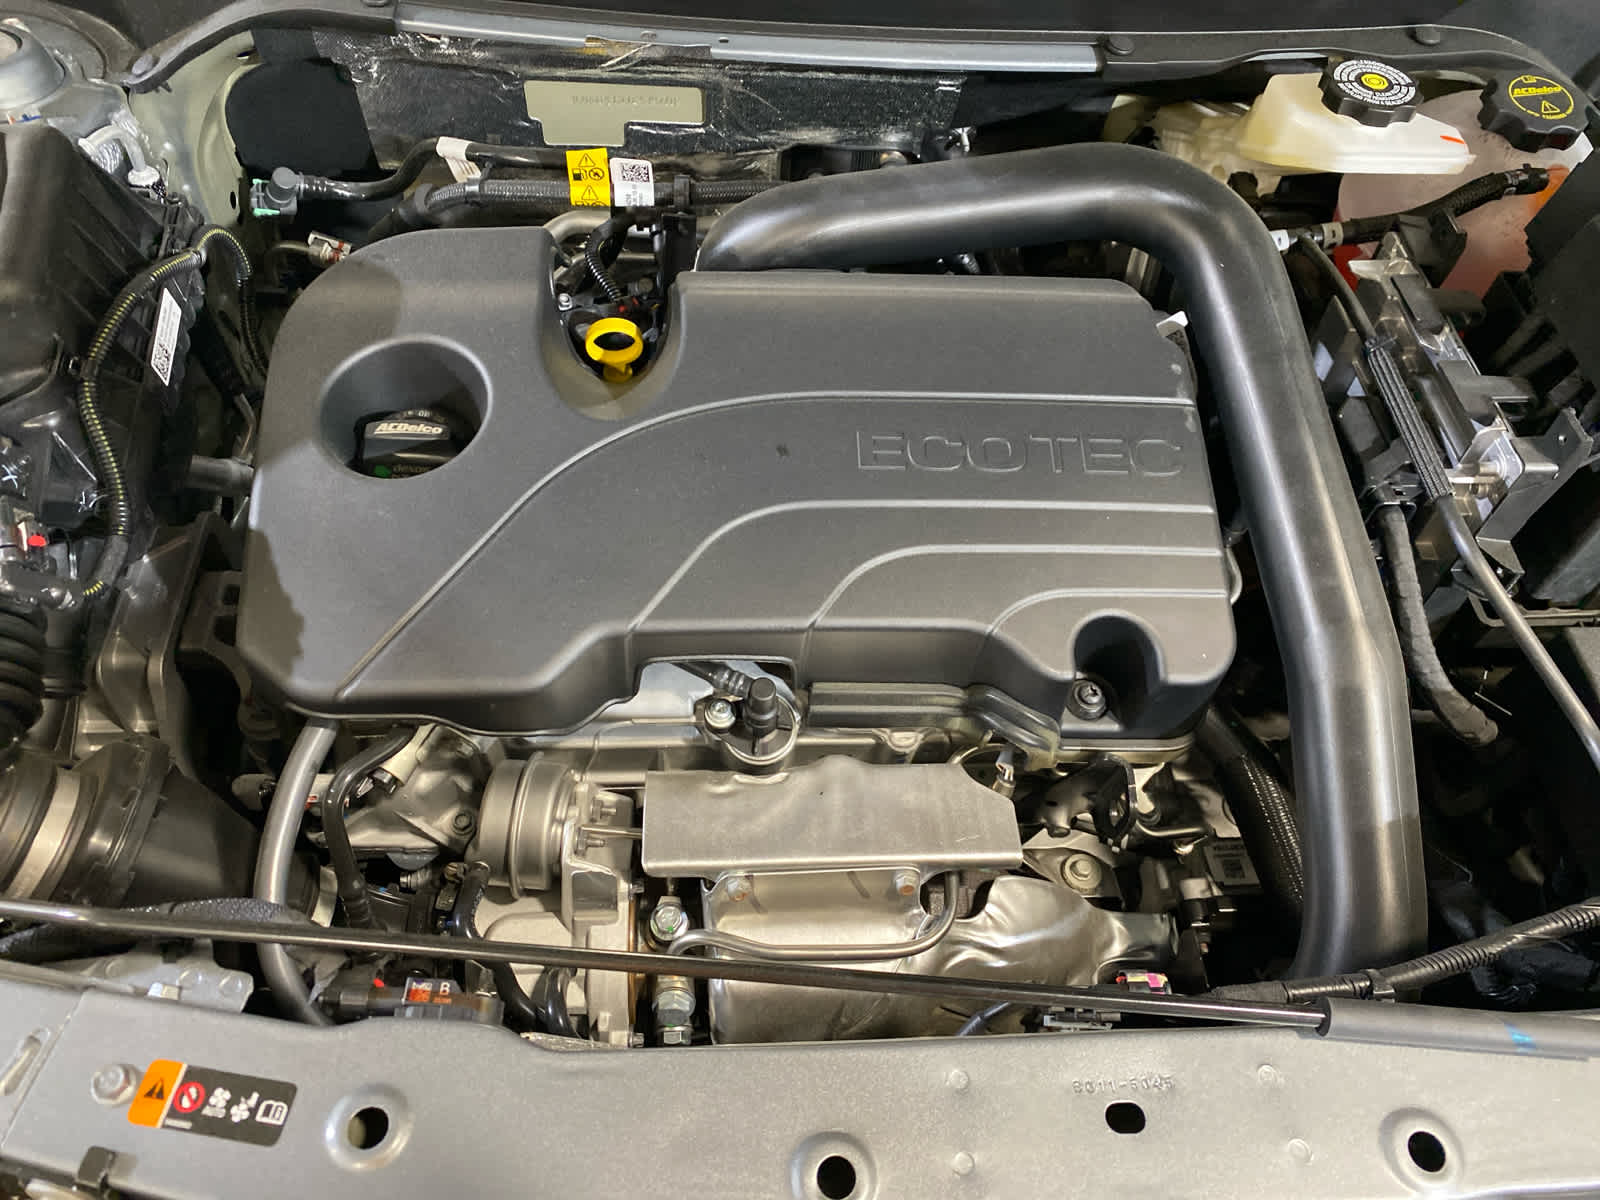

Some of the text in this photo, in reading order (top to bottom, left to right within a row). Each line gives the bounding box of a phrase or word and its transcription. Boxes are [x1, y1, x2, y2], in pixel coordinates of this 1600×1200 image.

[1512, 86, 1562, 97] ACDelco
[374, 422, 443, 434] ACDelco
[856, 431, 1183, 478] ECOTEC
